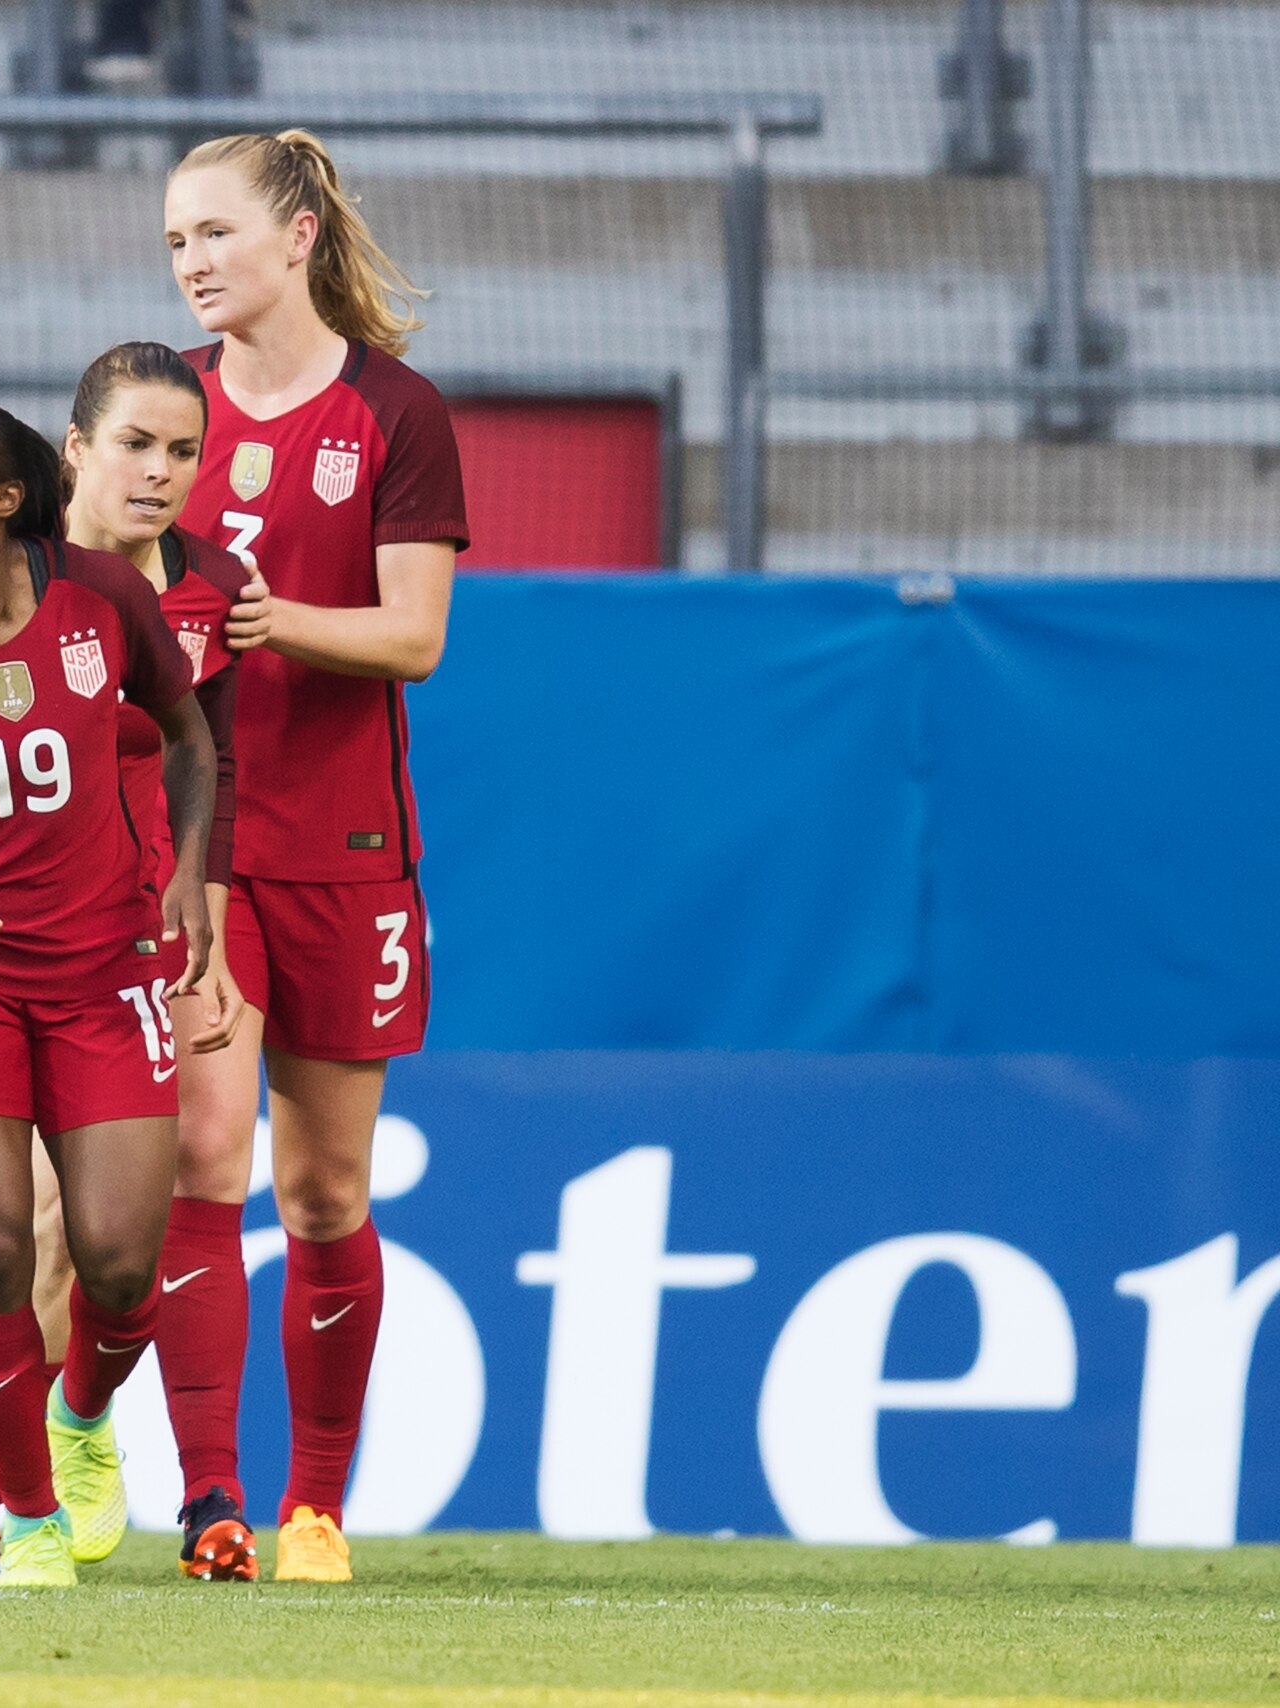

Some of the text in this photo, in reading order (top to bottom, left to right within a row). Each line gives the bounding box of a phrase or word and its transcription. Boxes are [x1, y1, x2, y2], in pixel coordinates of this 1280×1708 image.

[319, 452, 355, 475] USA
[64, 643, 99, 667] USA
[3, 698, 23, 708] FIFA
[373, 910, 410, 1001] 3
